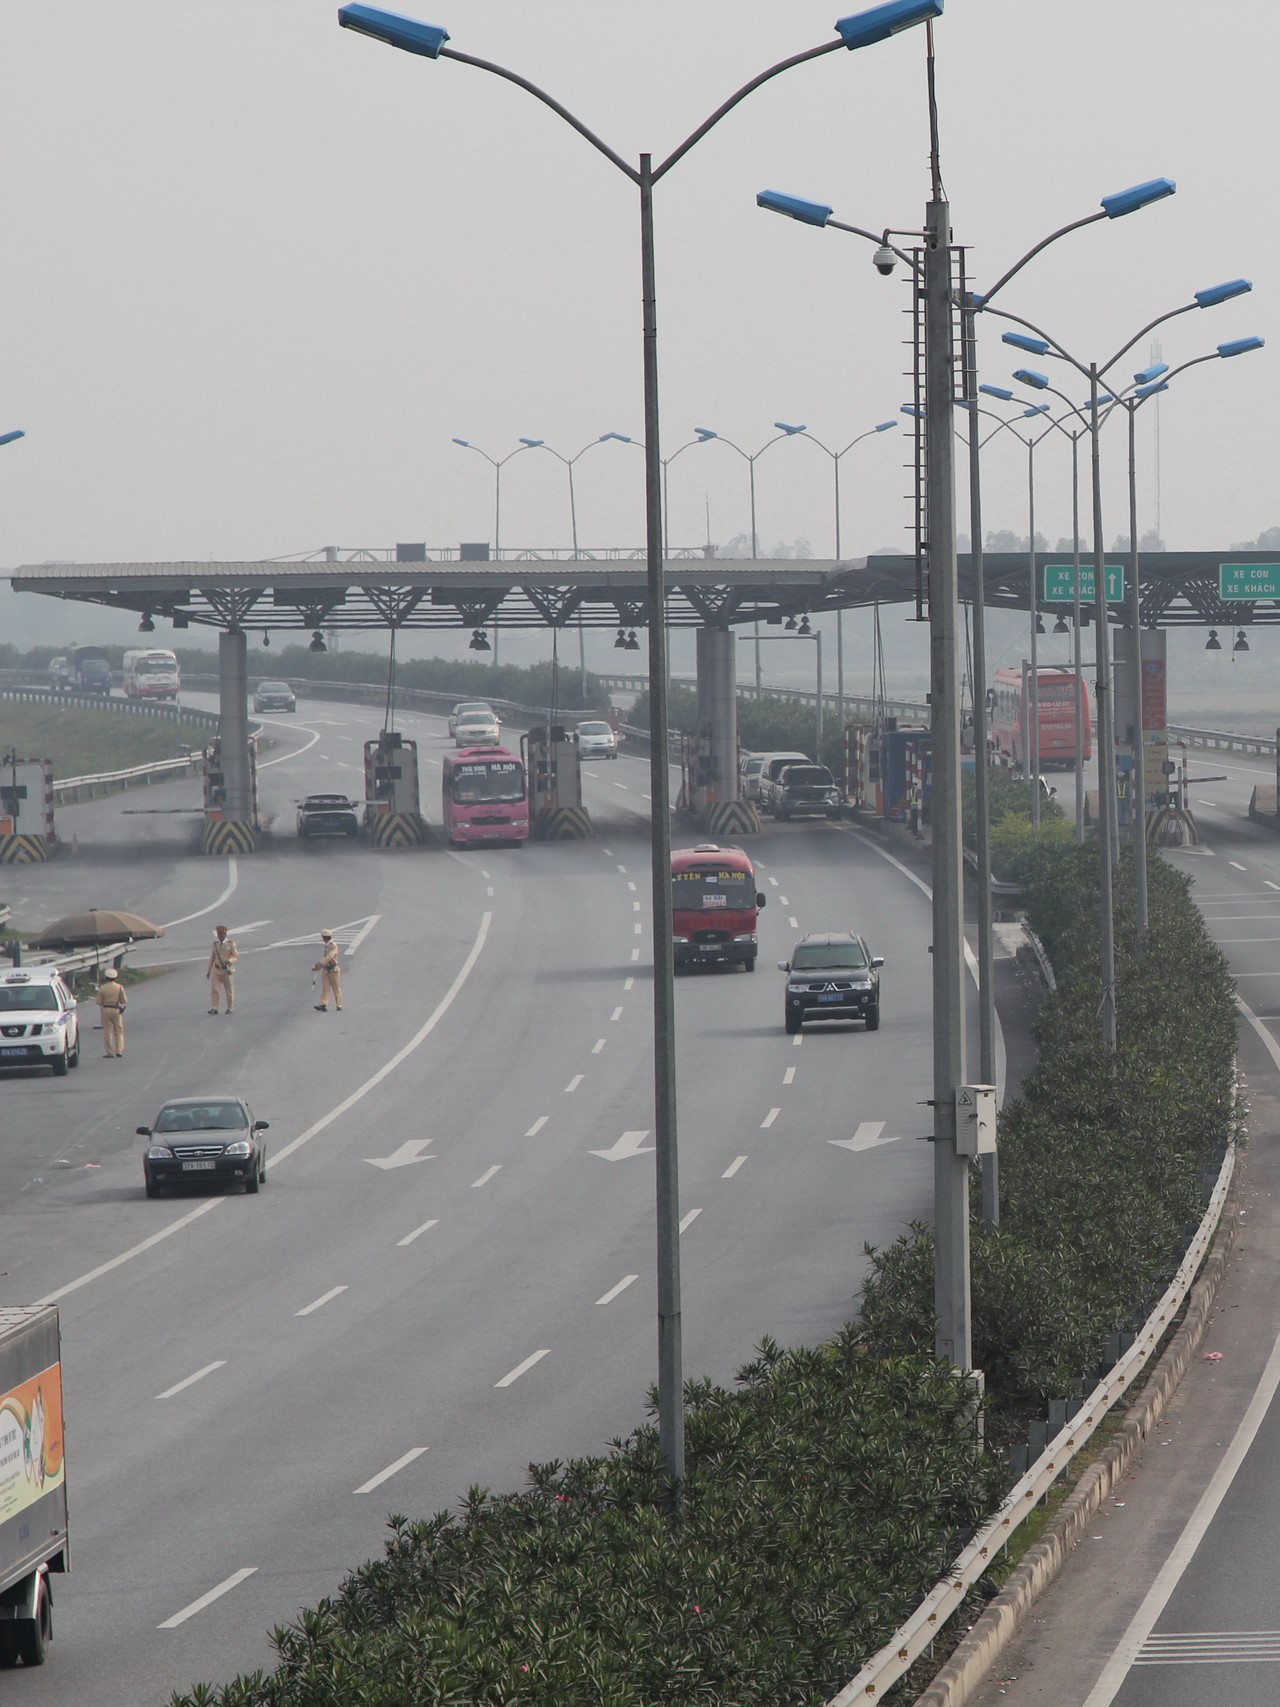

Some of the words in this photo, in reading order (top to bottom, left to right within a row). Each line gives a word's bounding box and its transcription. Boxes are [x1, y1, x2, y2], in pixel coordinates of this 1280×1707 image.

[1058, 572, 1070, 580] XE
[1077, 572, 1095, 580] ON
[1233, 570, 1245, 579] XE
[1250, 570, 1269, 579] CON
[1052, 586, 1064, 595] XE
[1069, 584, 1096, 595] KÁC
[1227, 584, 1239, 593] XE
[1244, 582, 1276, 593] KHÁCH
